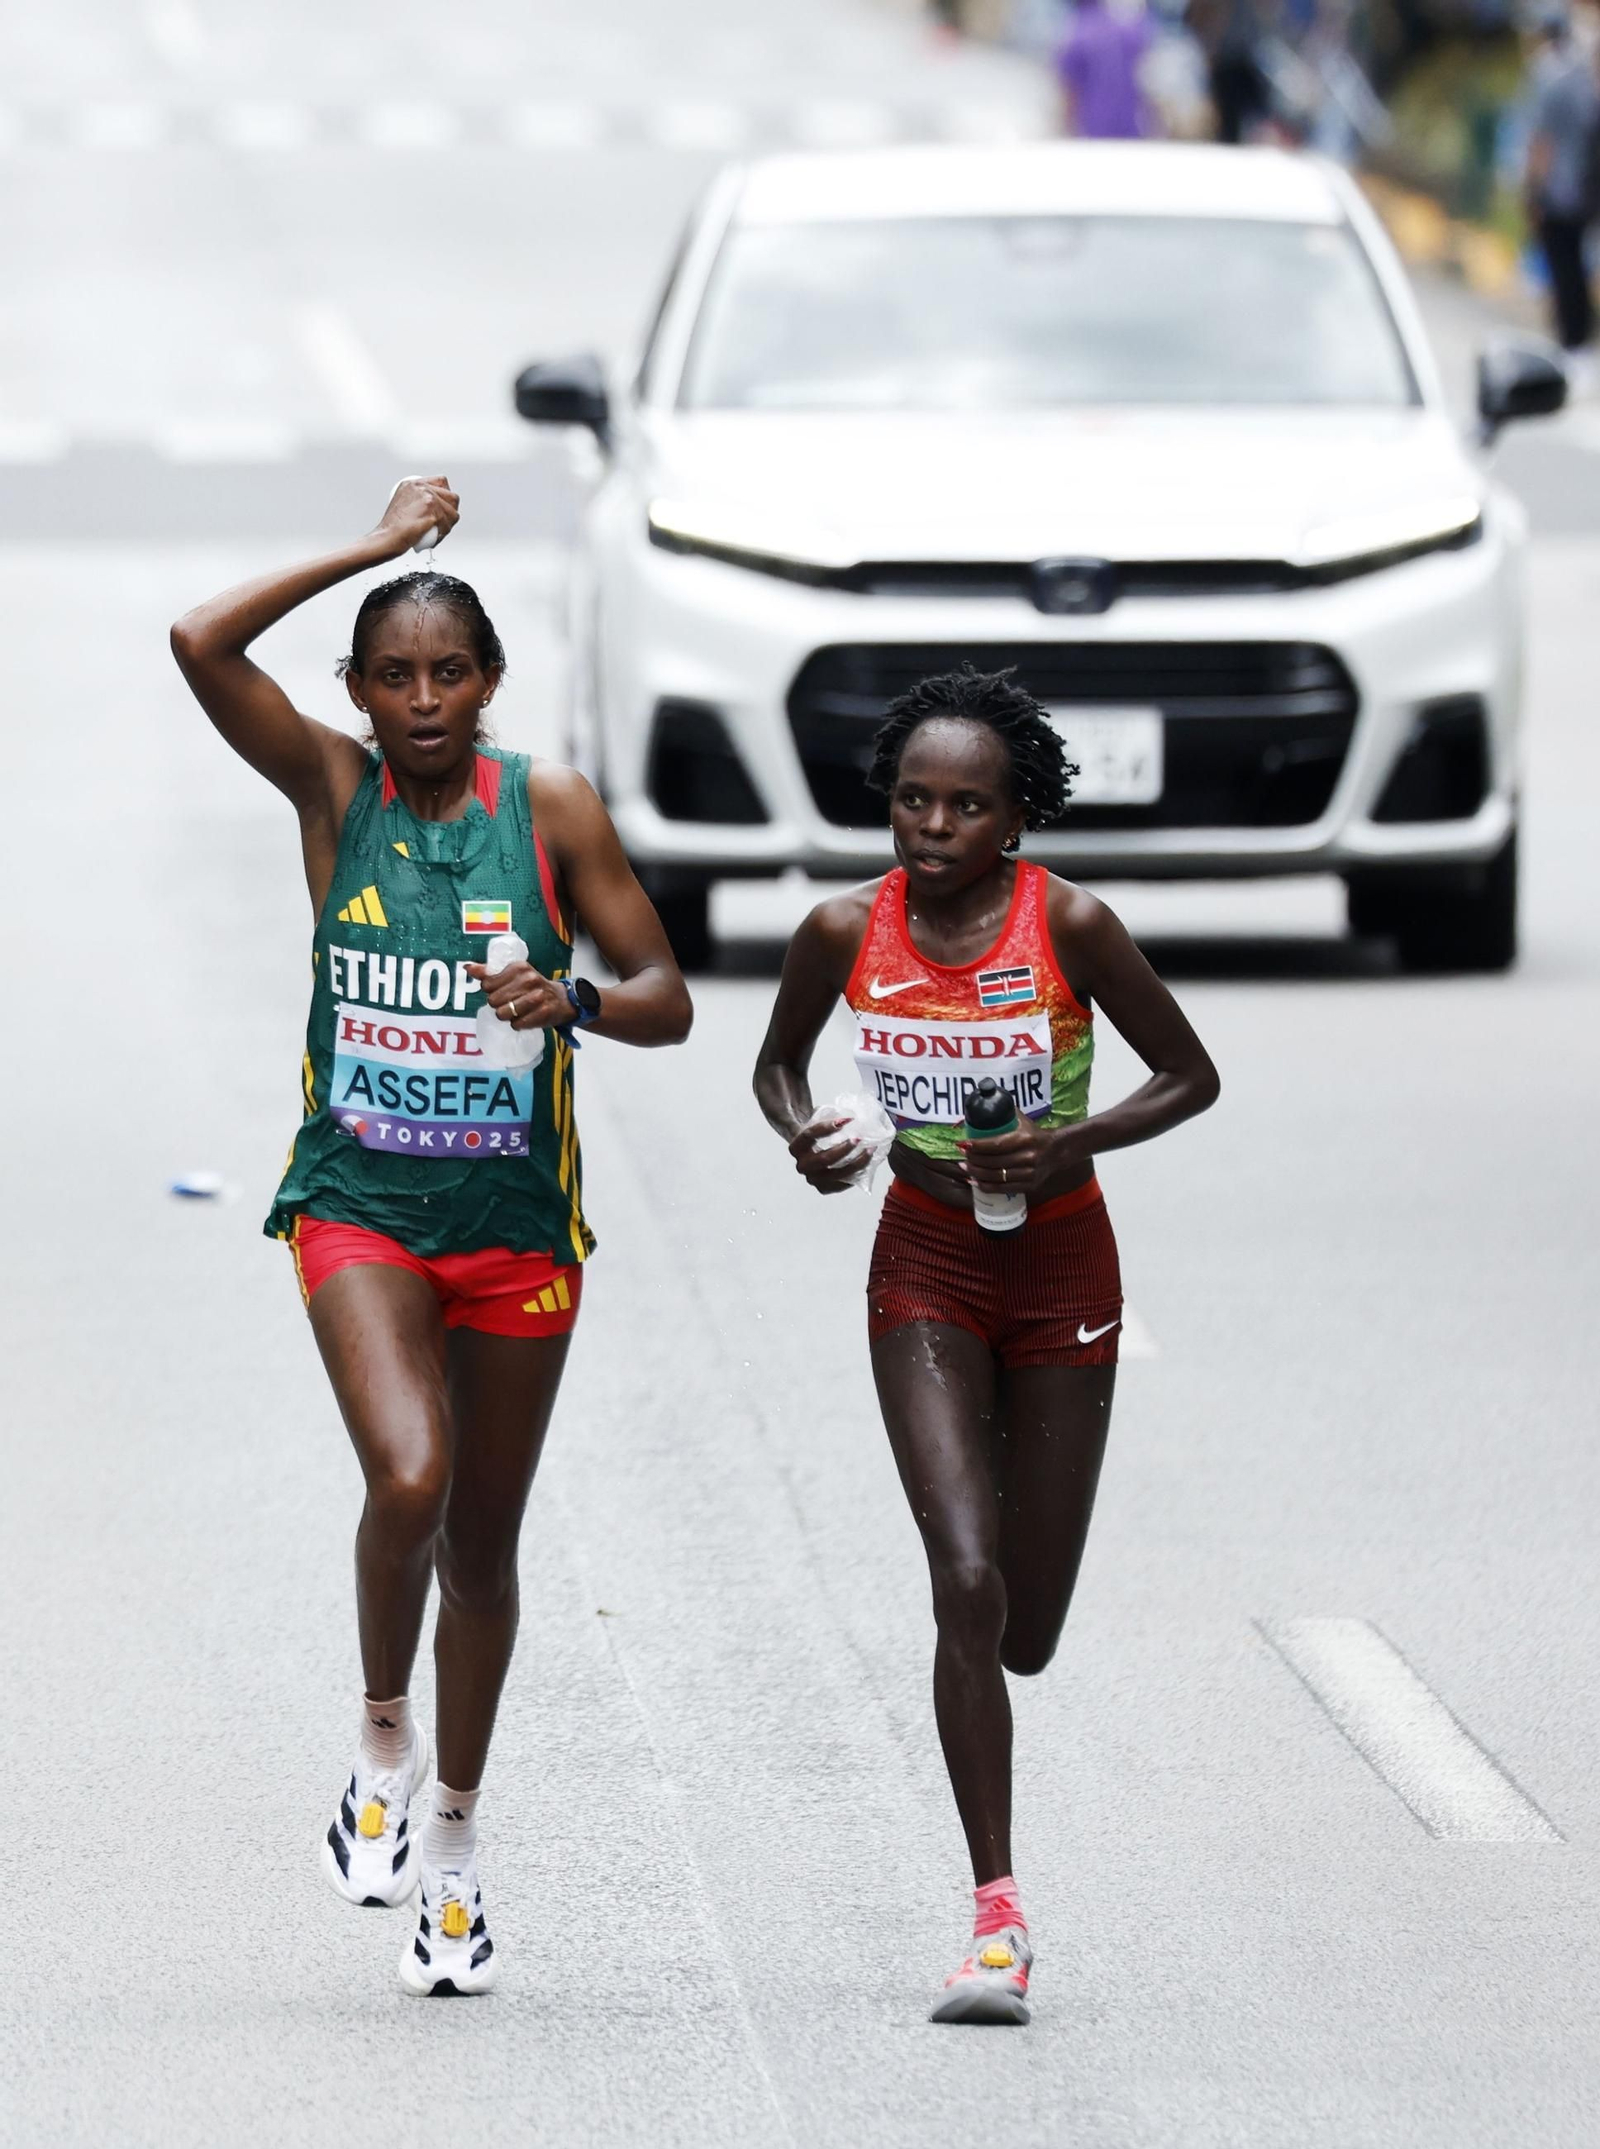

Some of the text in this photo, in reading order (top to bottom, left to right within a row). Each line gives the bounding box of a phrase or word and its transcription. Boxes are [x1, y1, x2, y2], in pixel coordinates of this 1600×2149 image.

[329, 943, 482, 1011] ETHIOP
[340, 1016, 484, 1056] HOND
[859, 1028, 1047, 1059] HONDA
[342, 1064, 520, 1116] ASSEFA
